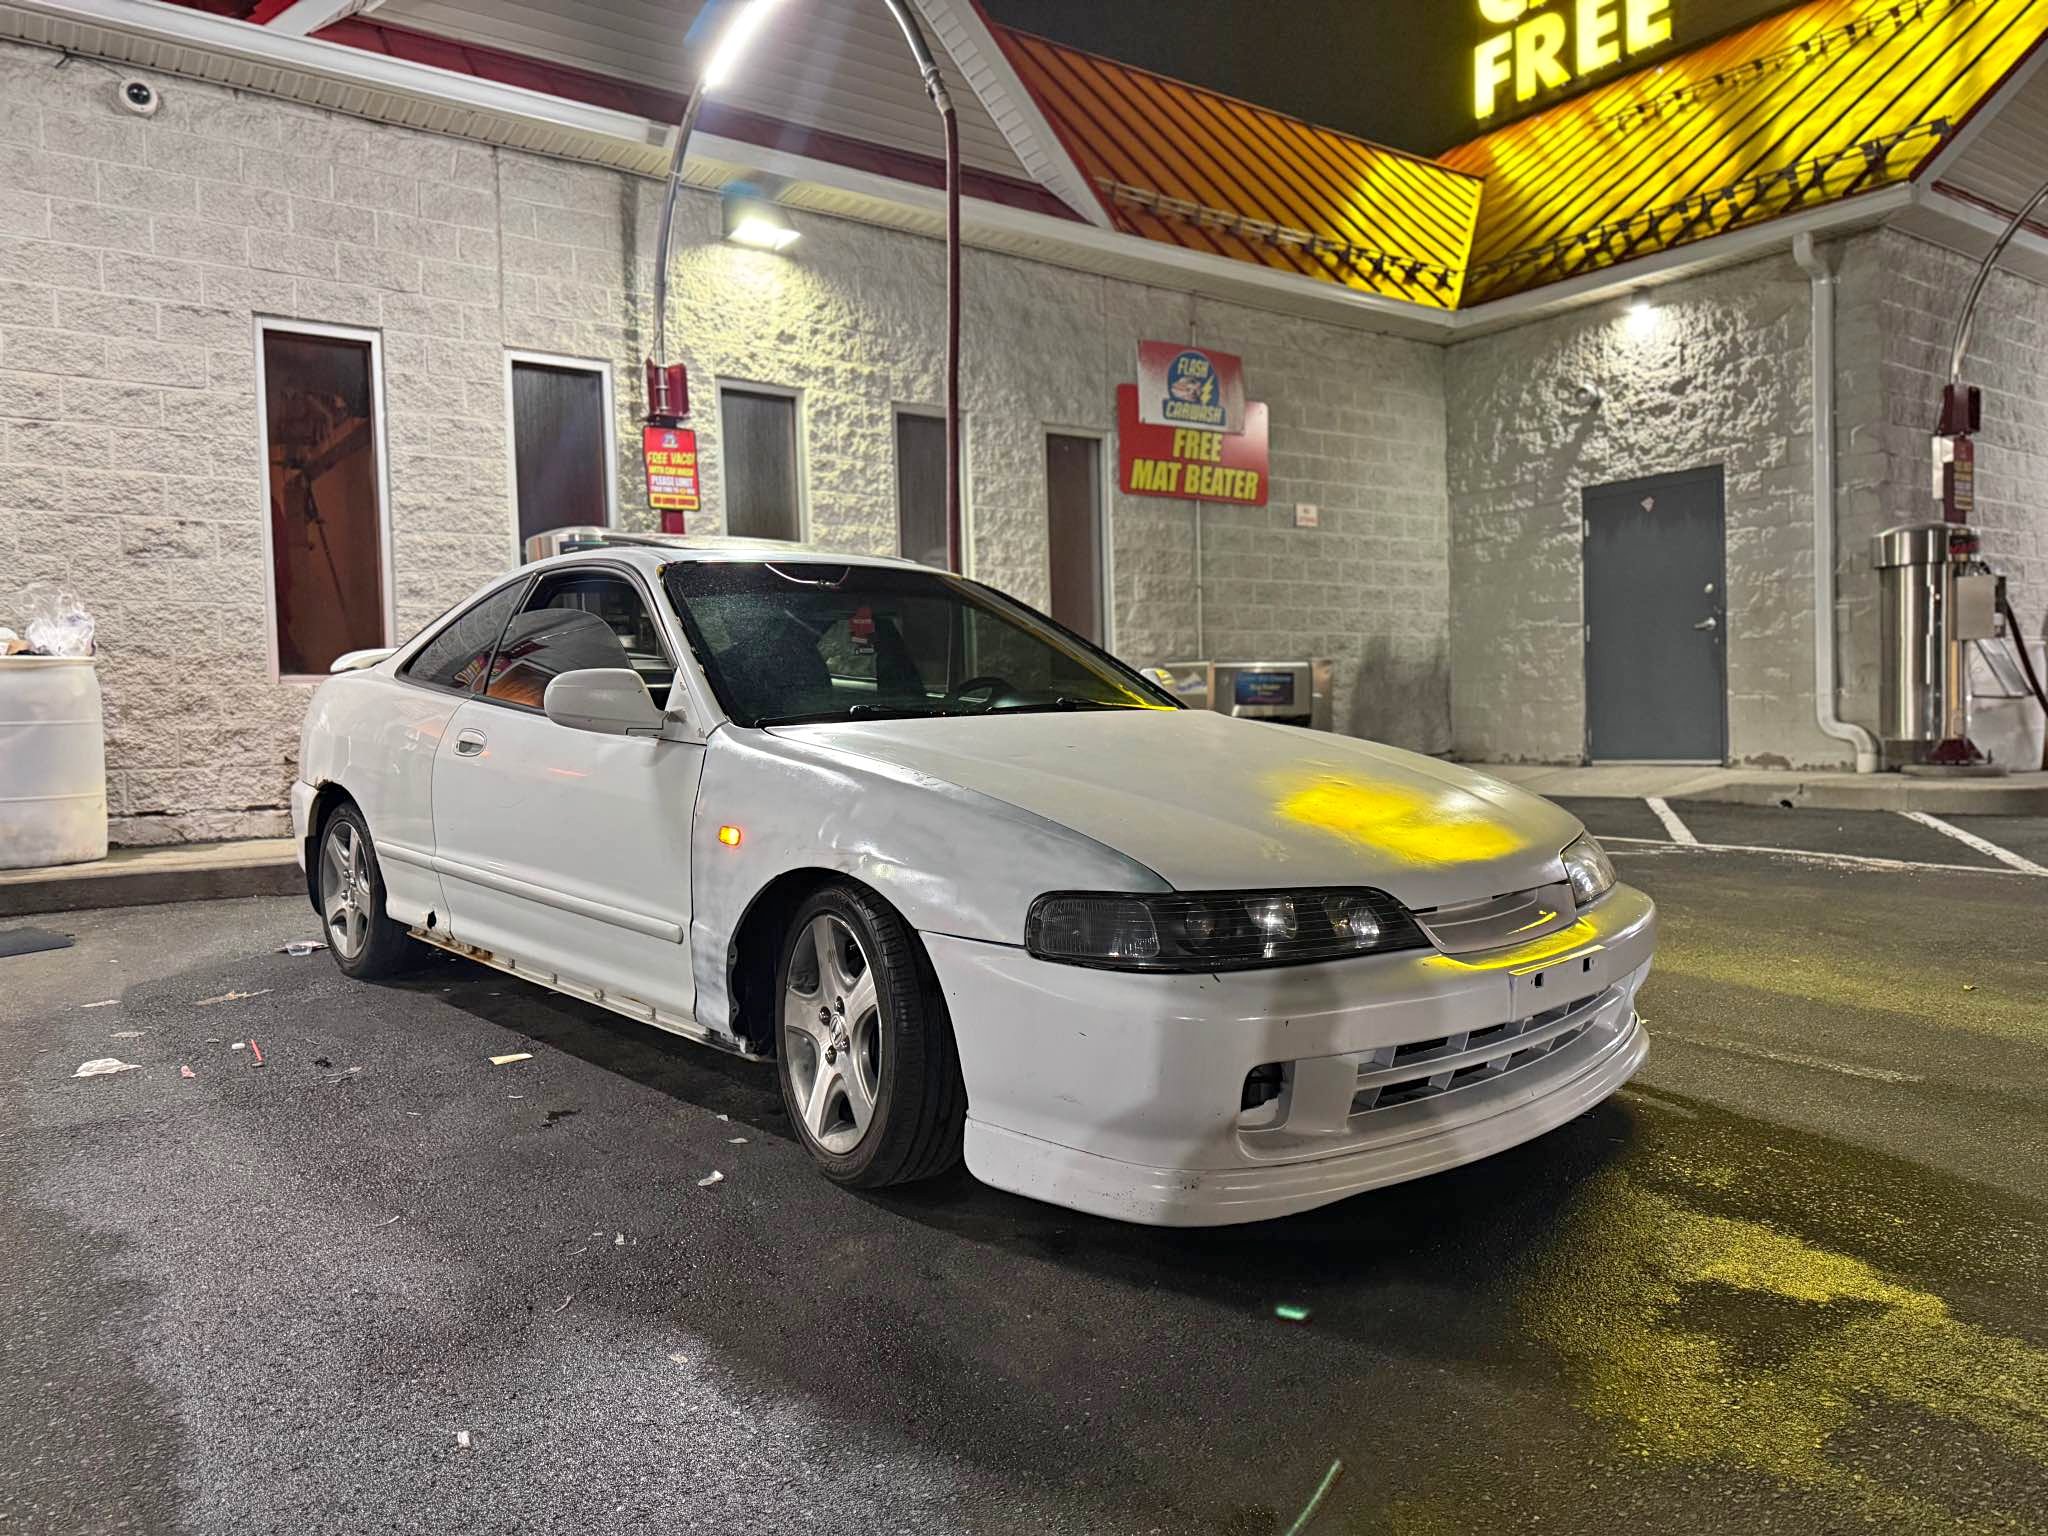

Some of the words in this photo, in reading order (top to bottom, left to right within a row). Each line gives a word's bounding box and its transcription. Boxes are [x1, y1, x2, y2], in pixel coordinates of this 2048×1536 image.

[1474, 0, 1671, 119] FREE
[647, 451, 670, 464] FREE
[1172, 428, 1223, 462] FREE
[1130, 458, 1182, 492] MAT
[1184, 463, 1259, 500] BEATER
